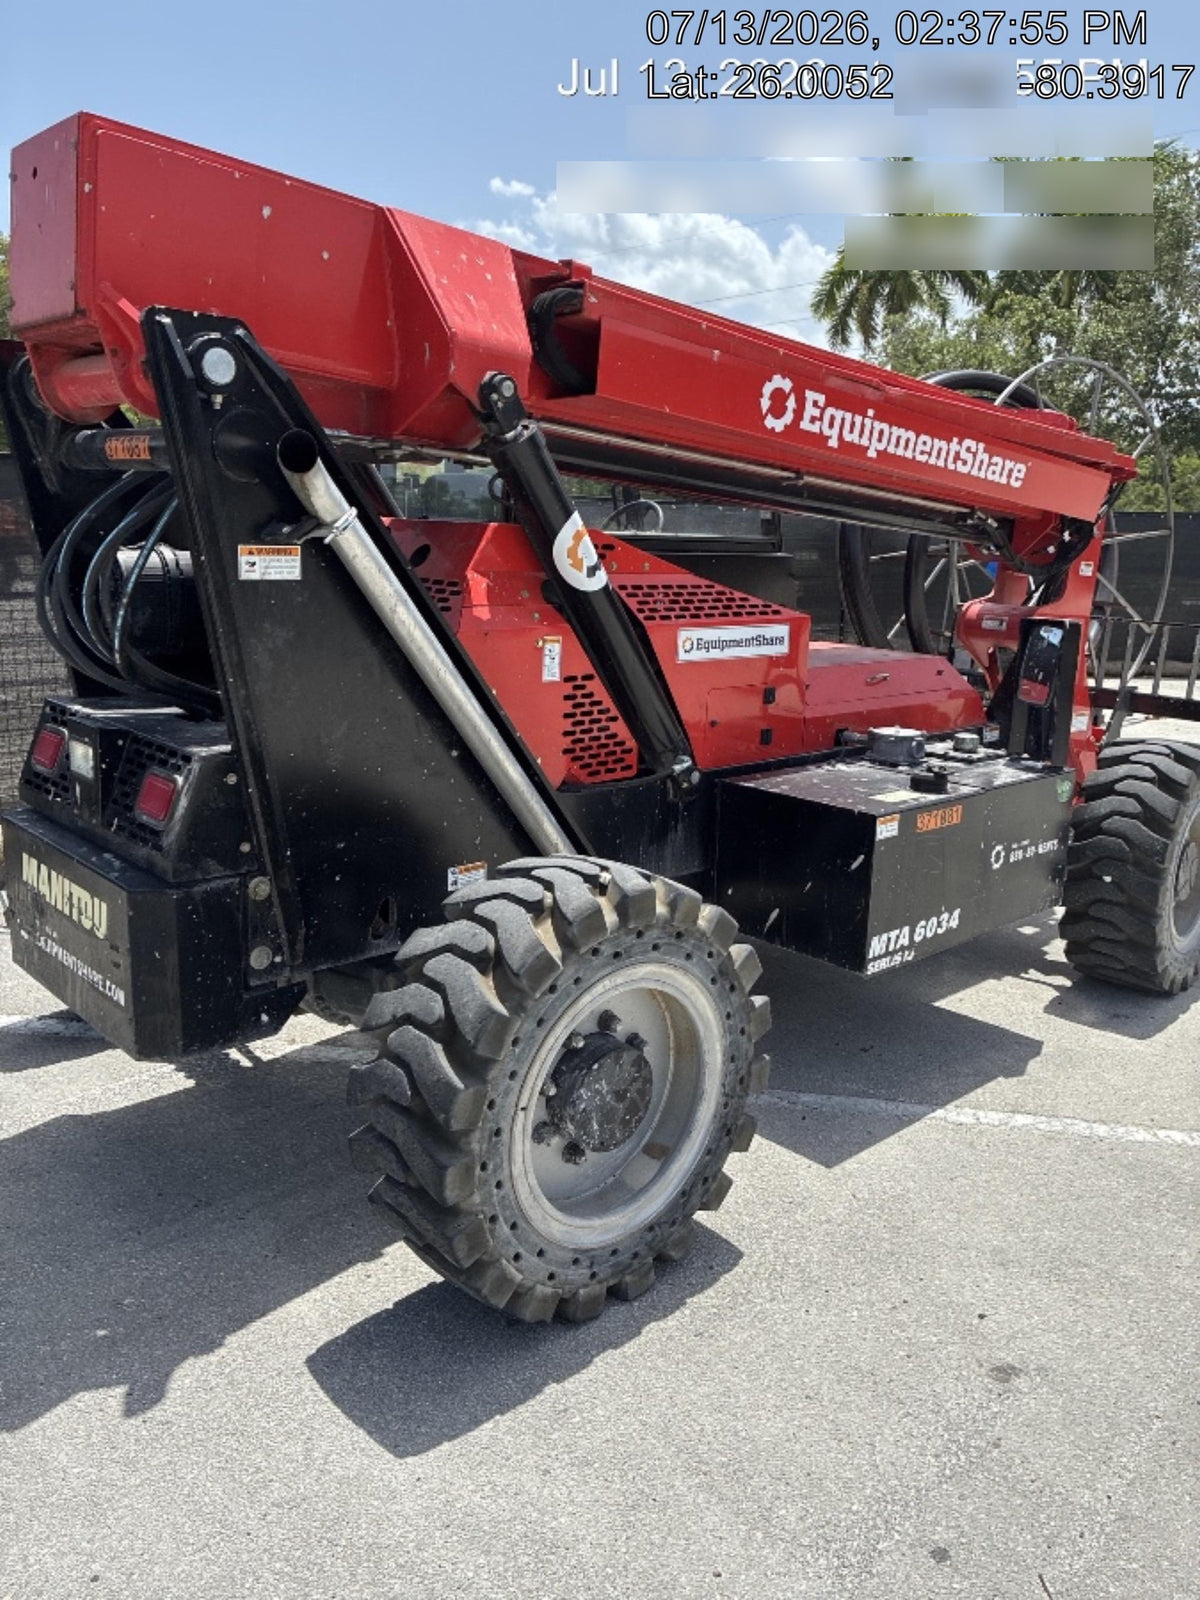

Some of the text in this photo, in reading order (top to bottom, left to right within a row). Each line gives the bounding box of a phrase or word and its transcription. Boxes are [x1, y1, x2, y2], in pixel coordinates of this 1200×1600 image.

[800, 389, 1027, 488] EquipmentShare
[696, 634, 785, 652] EquipmentShare
[22, 852, 108, 939] MANITOU
[868, 908, 961, 959] MTA 6034
